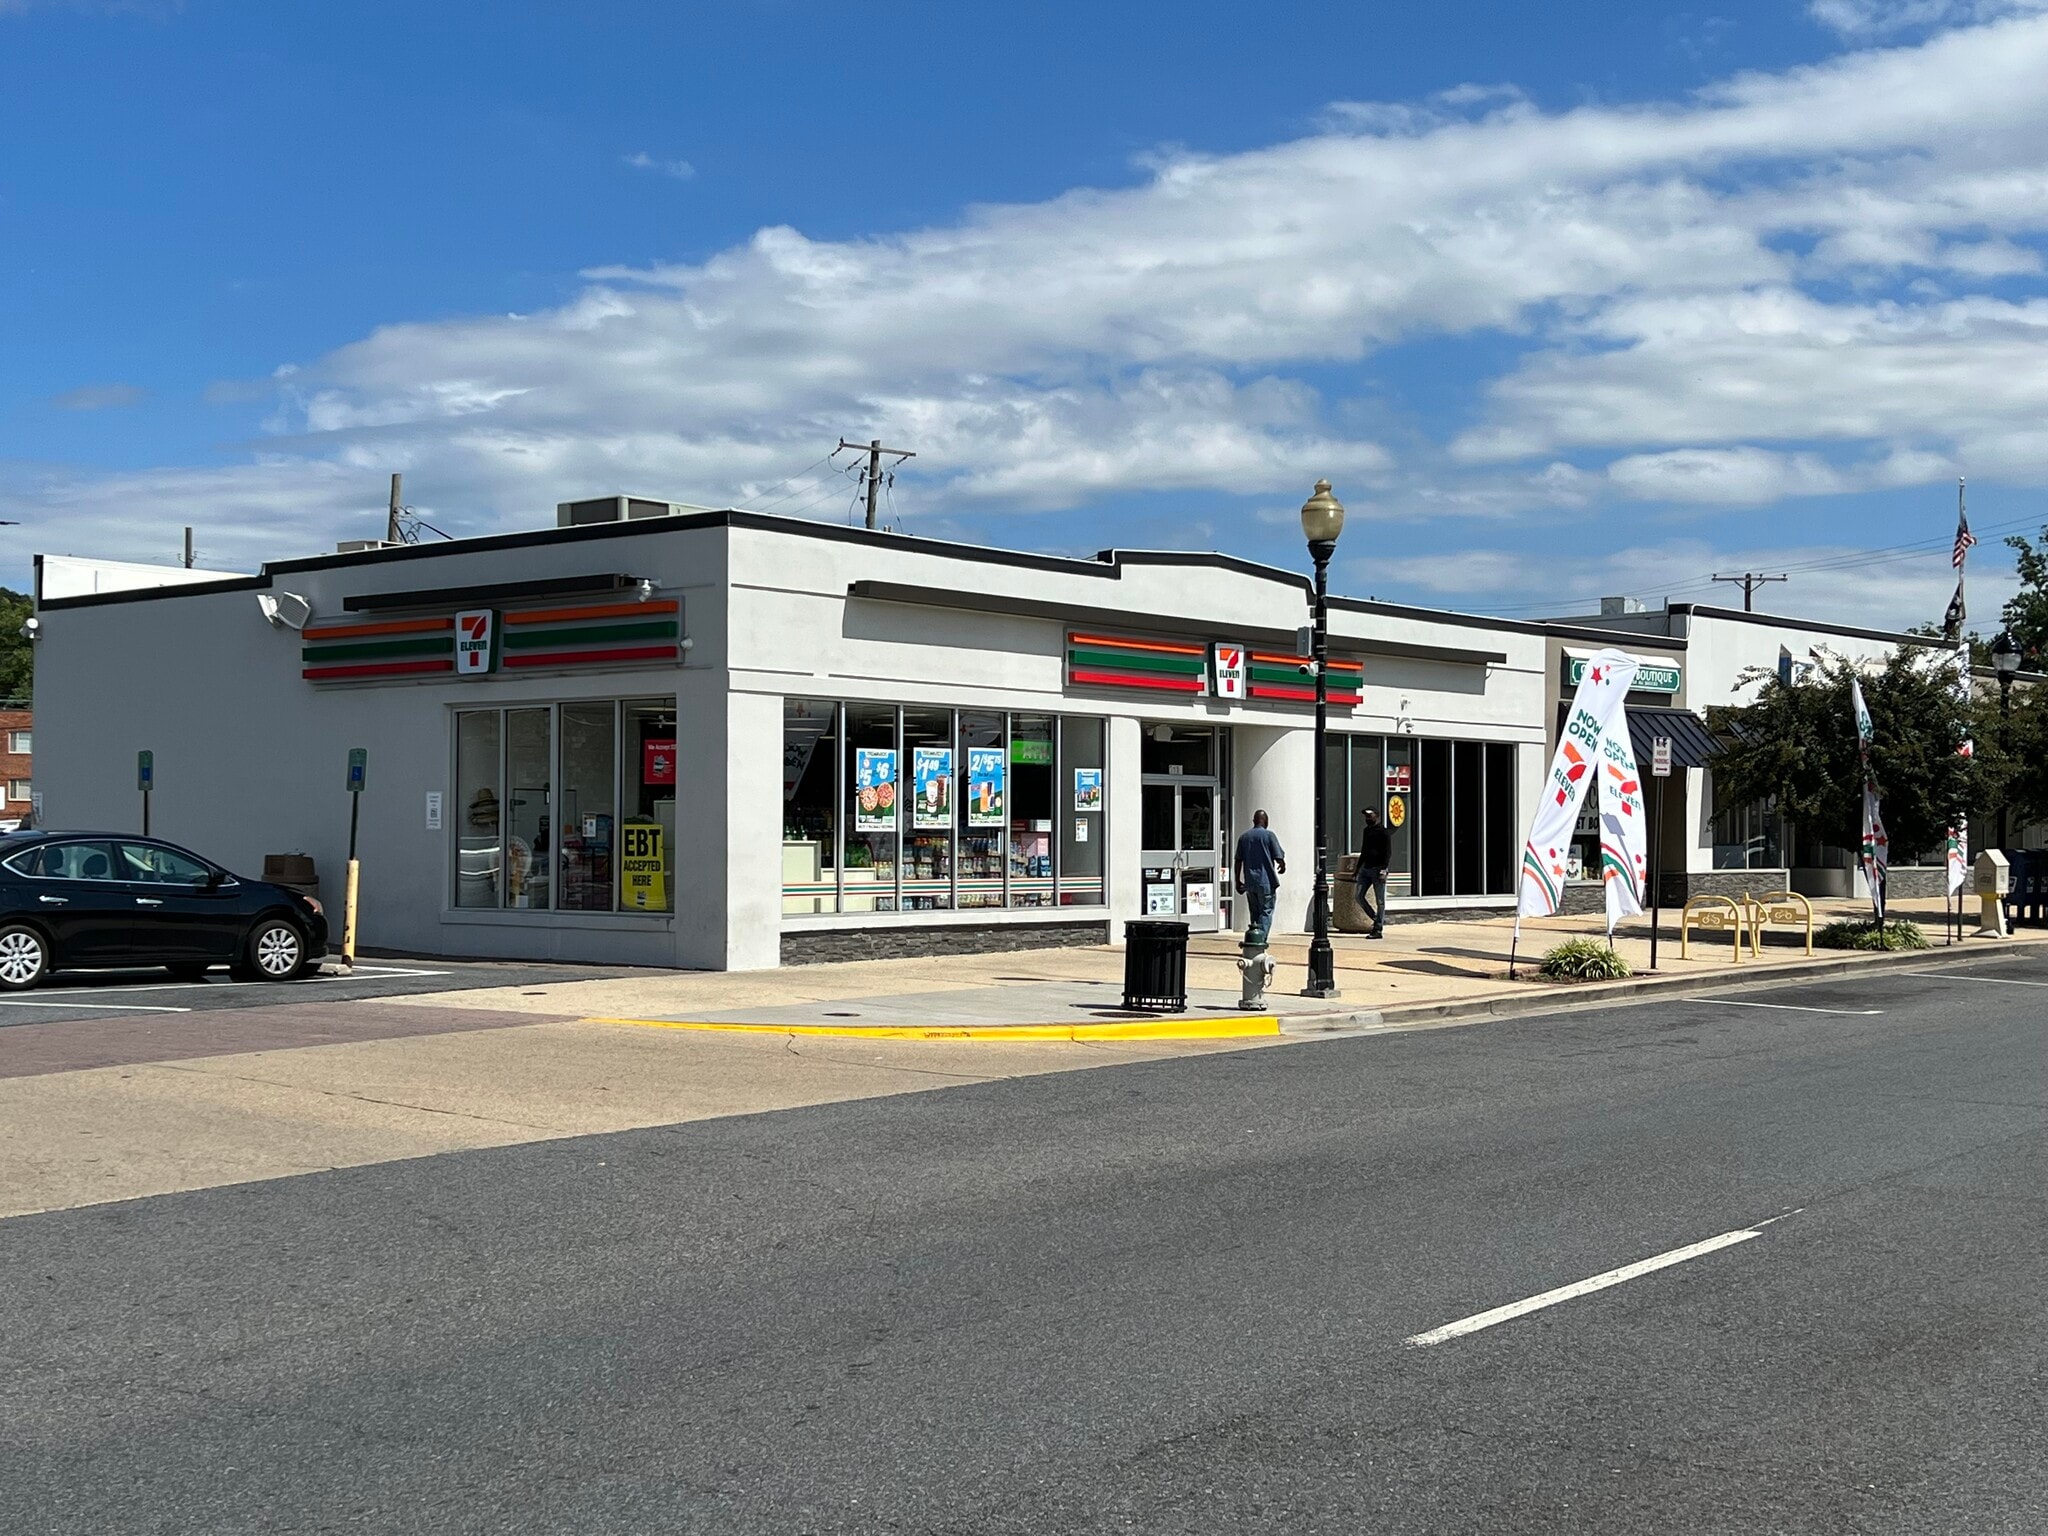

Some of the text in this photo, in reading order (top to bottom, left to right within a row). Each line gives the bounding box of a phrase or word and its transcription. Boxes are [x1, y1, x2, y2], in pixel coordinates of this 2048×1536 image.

[462, 616, 487, 667] 7
[1220, 648, 1239, 692] 7
[1576, 709, 1602, 736] NOW
[1569, 722, 1598, 753] OPEN
[859, 768, 872, 786] $5
[876, 761, 889, 780] $6
[624, 829, 660, 857] EBT
[624, 860, 661, 872] ACCEPTED
[632, 875, 652, 886] HERE
